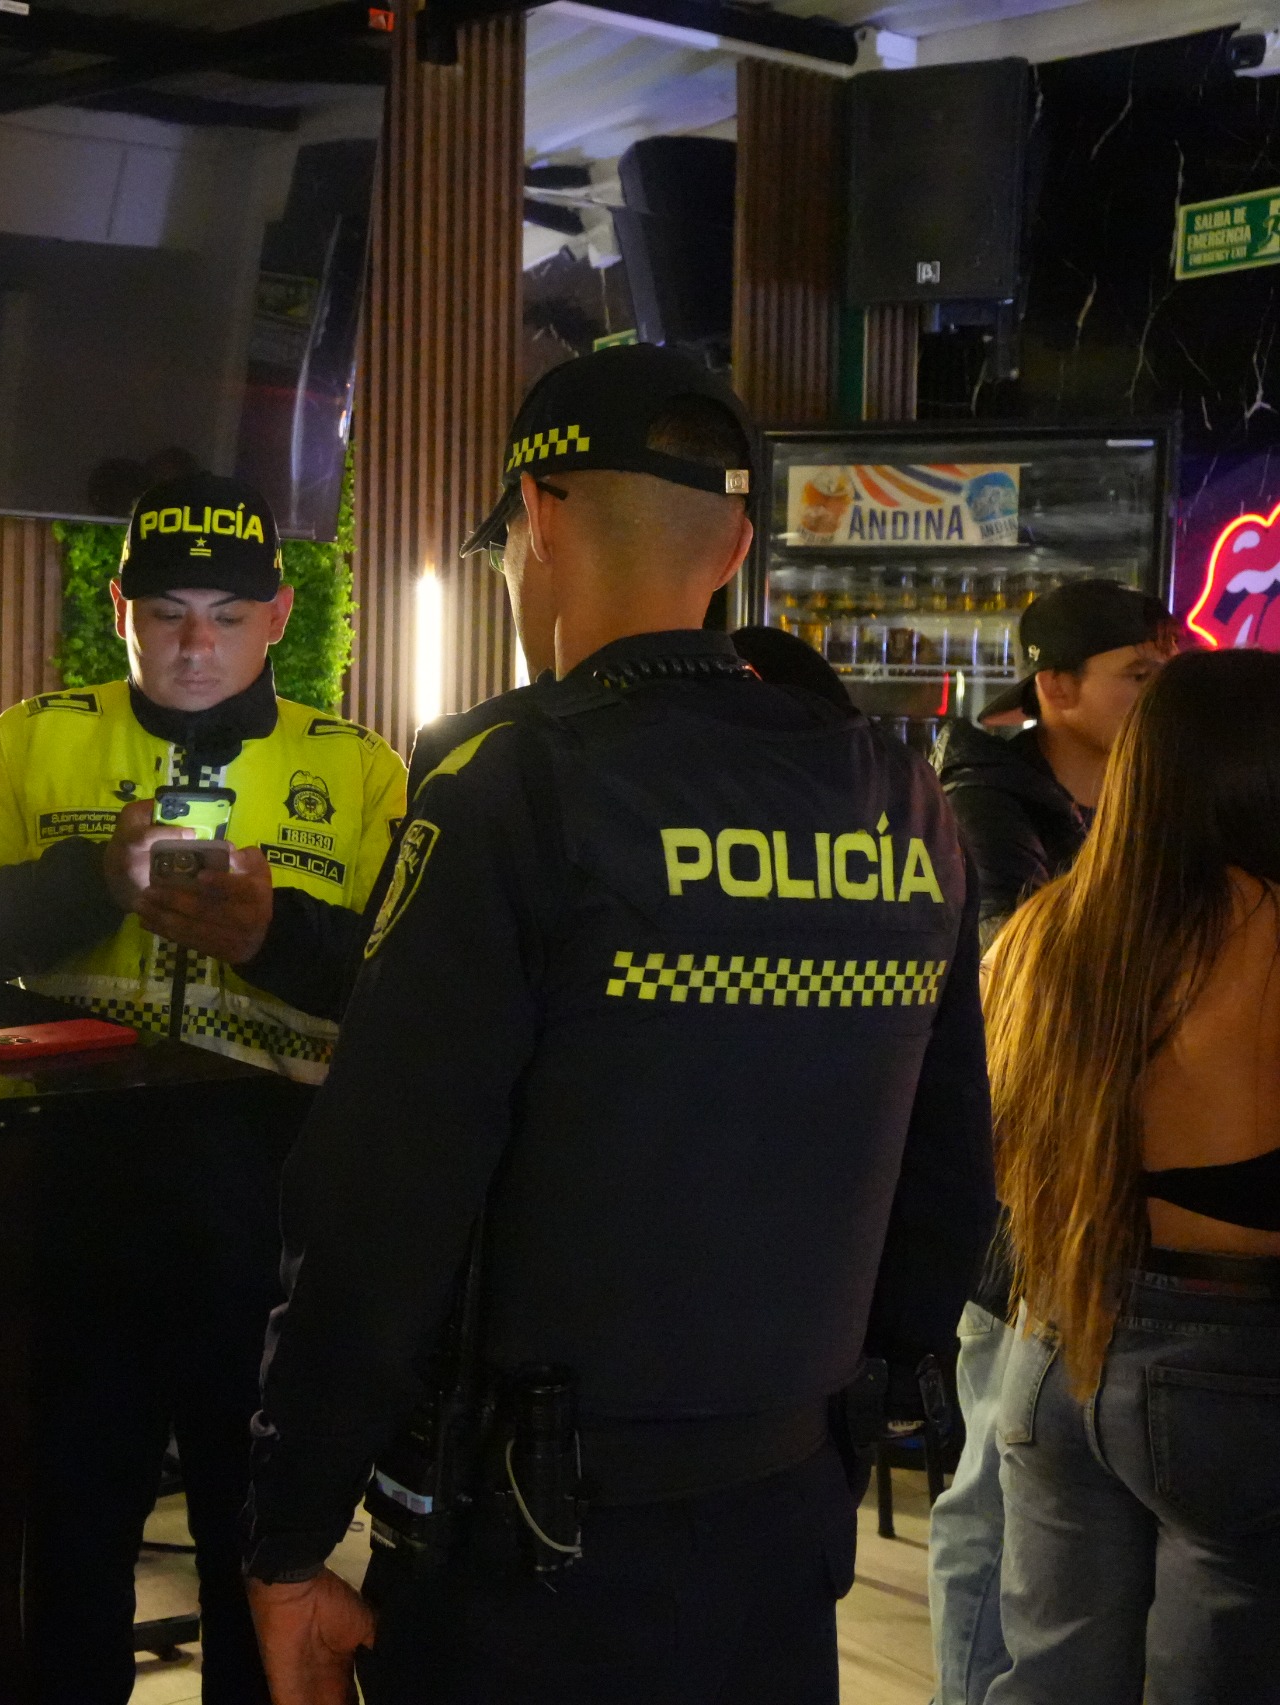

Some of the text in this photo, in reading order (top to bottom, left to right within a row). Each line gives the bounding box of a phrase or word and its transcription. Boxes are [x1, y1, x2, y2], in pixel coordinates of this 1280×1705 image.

[1194, 209, 1231, 231] SALIDA
[1187, 225, 1251, 251] EMERGENCIA
[140, 502, 264, 544] POLICÍA
[848, 504, 965, 540] ANDINA
[79, 821, 117, 833] SUÁRE
[266, 849, 340, 881] POLICÍA
[660, 811, 945, 904] POLICÍA
